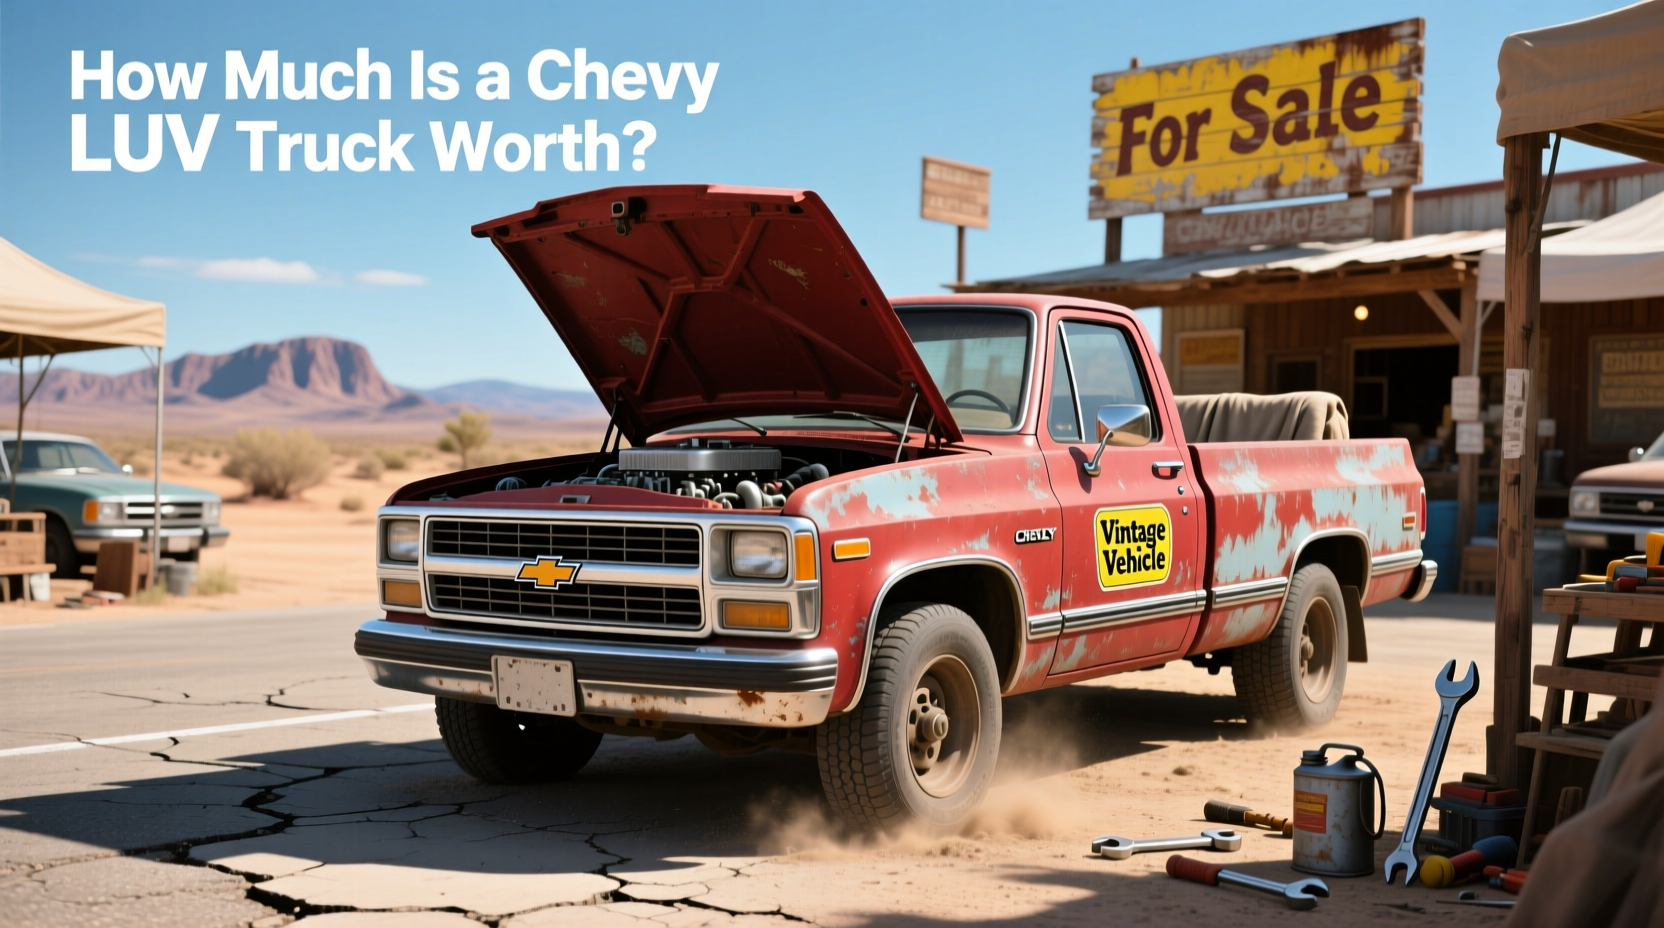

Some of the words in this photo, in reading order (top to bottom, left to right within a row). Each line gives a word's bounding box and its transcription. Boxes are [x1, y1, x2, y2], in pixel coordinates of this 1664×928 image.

[1116, 102, 1212, 177] For
[1229, 61, 1382, 155] Sale
[1100, 519, 1166, 548] Vintage
[1103, 545, 1166, 576] Vehicle
